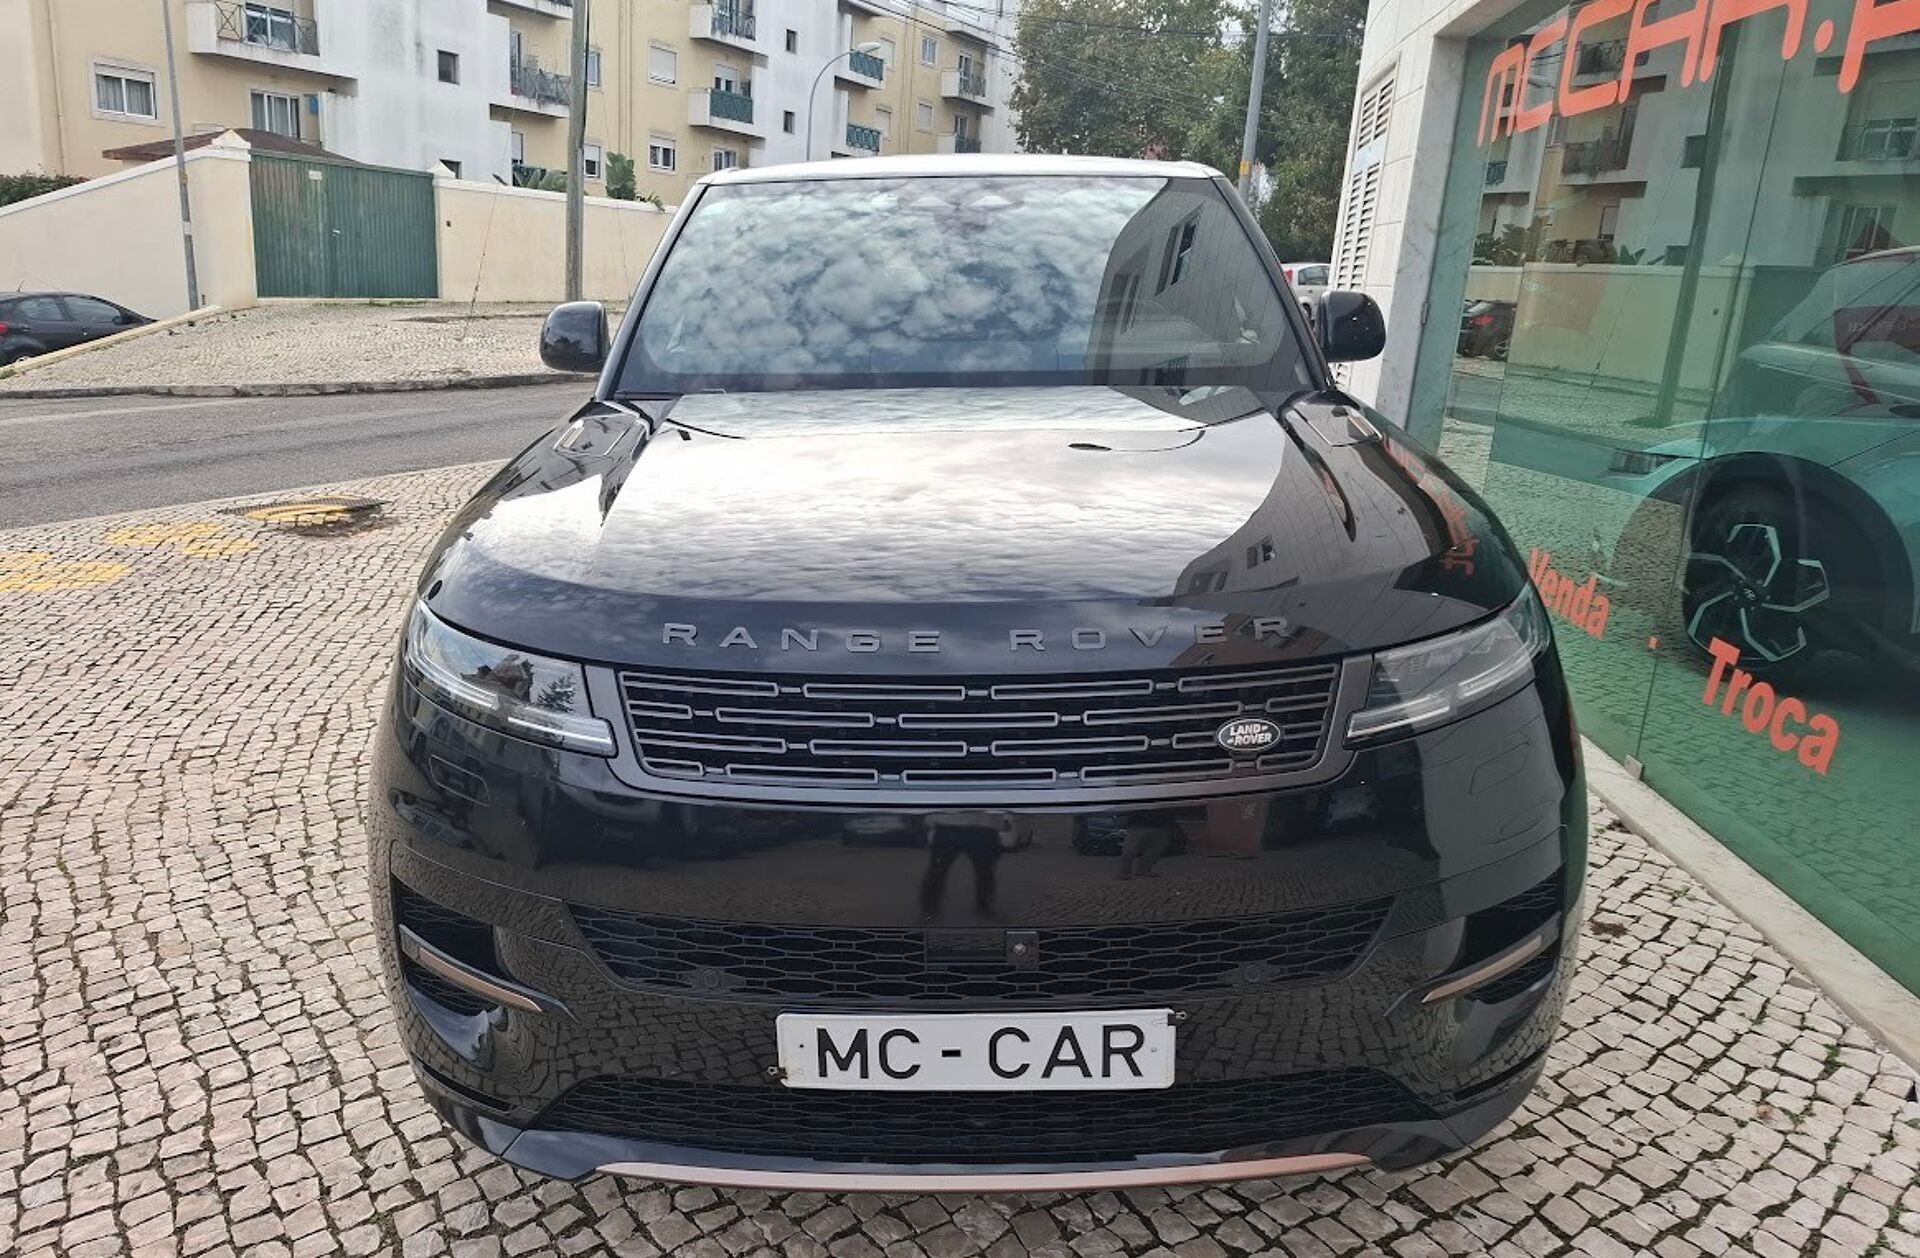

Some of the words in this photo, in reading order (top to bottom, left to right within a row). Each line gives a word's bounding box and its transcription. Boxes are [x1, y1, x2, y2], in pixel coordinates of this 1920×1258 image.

[661, 622, 940, 652] RANGE
[1008, 616, 1291, 651] ROVER
[1528, 547, 1610, 640] Venda
[1702, 636, 1839, 776] Troca
[816, 1028, 921, 1080] MC
[988, 1024, 1145, 1079] CAR
